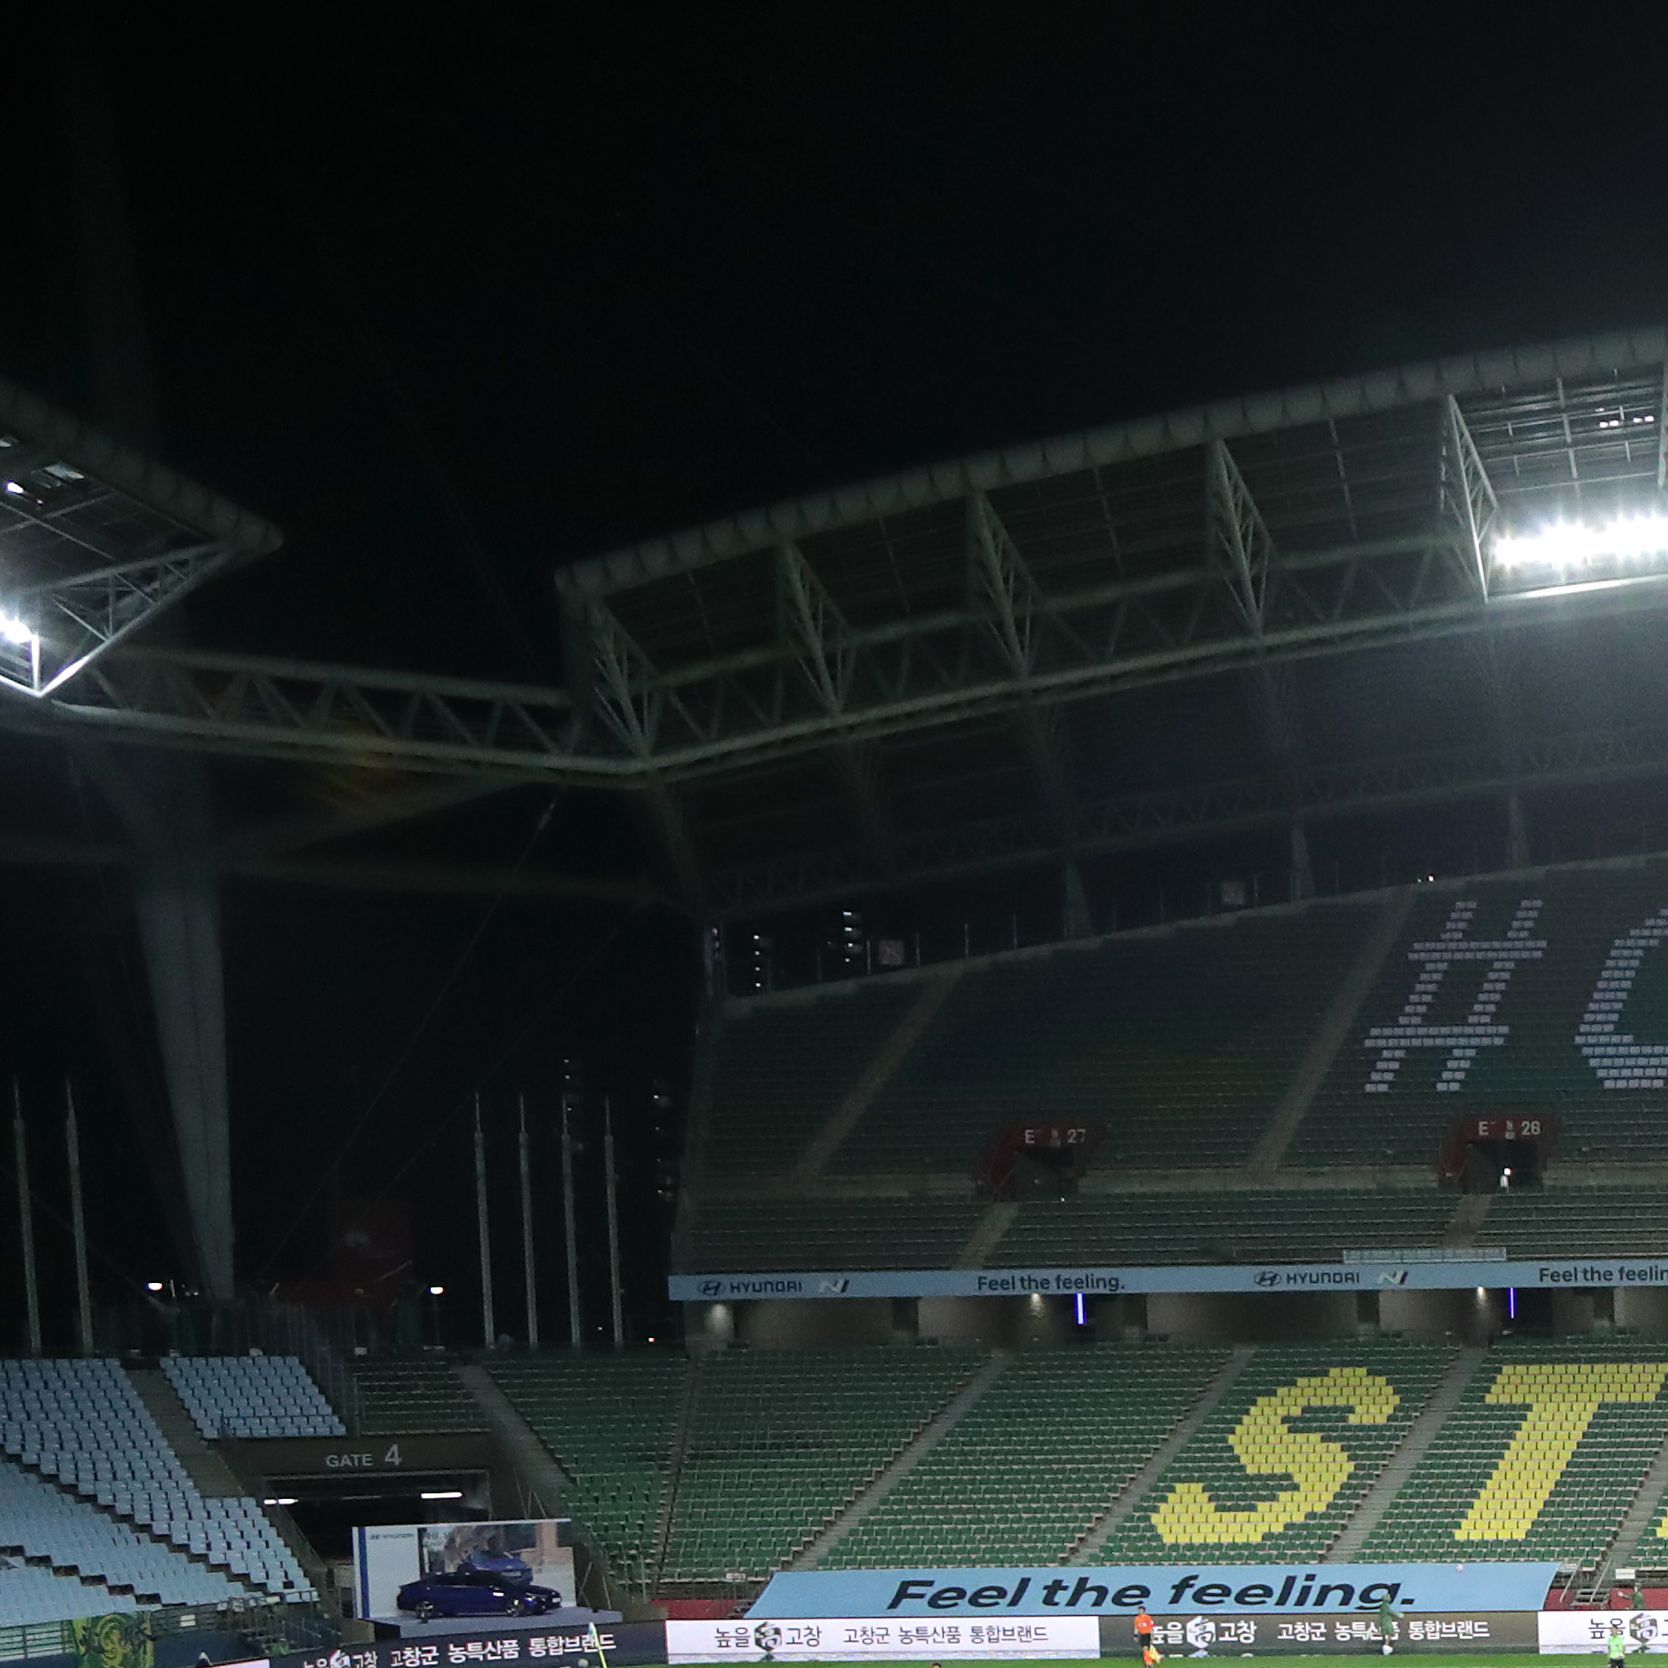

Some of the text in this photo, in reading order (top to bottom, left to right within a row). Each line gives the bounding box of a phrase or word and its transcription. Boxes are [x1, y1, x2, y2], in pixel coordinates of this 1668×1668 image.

[1067, 1129, 1086, 1144] 27
[1521, 1121, 1541, 1136] 26
[977, 1274, 1125, 1294] Feel the feeling.
[1286, 1272, 1359, 1284] HYUNDAI
[1539, 1266, 1577, 1282] Feel
[1581, 1266, 1613, 1282] the
[730, 1280, 802, 1294] HYUNDAI
[325, 1444, 402, 1467] GATE 4
[887, 1574, 1416, 1611] Feel the feeling.
[844, 1622, 889, 1645] 고창군
[898, 1622, 961, 1645] 농특산품
[969, 1622, 1048, 1645] 통합브랜드
[1278, 1620, 1325, 1643] 고창군
[1408, 1620, 1490, 1643] 통합브랜드
[390, 1647, 439, 1668] 고창군
